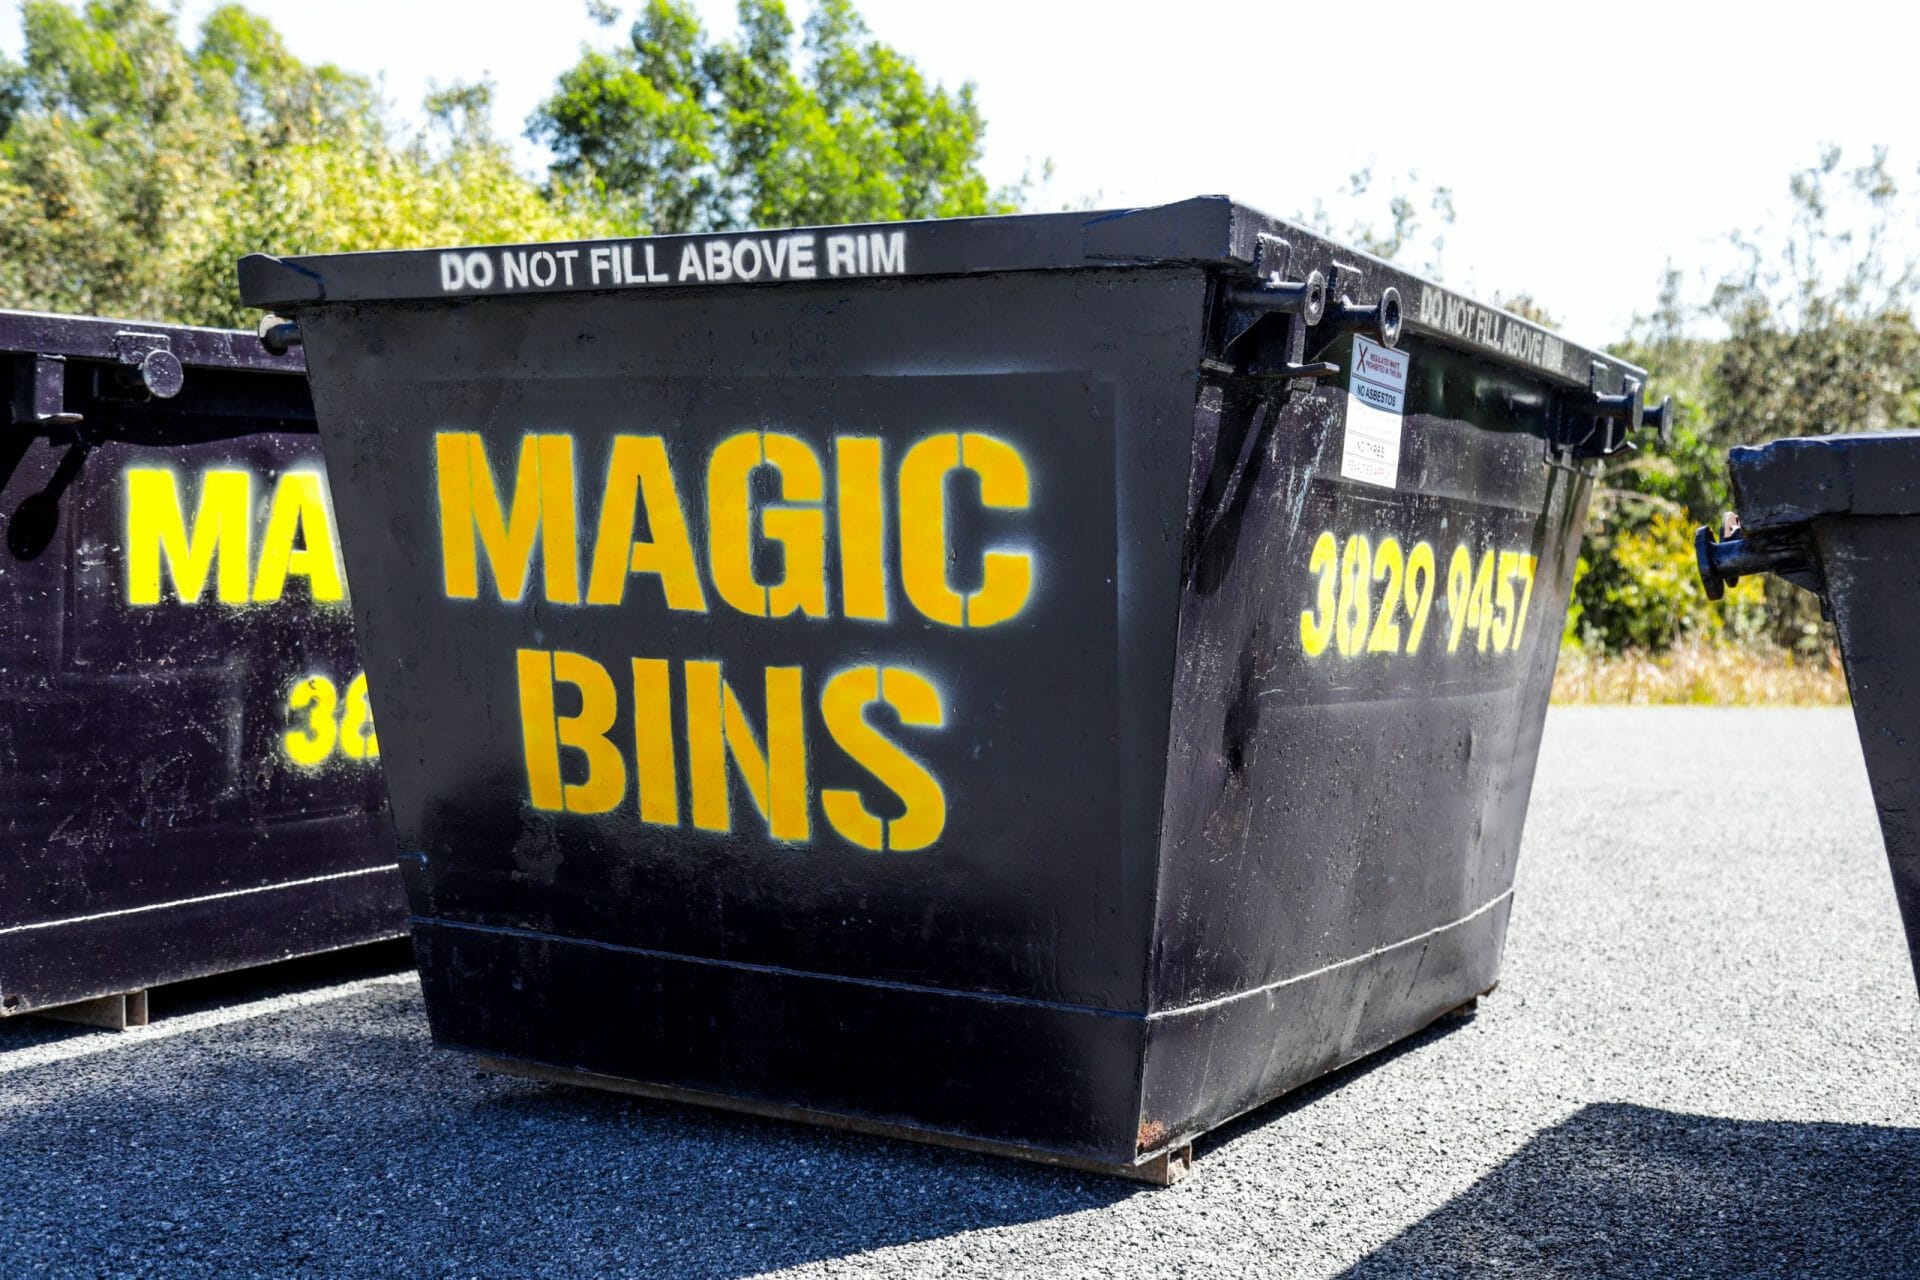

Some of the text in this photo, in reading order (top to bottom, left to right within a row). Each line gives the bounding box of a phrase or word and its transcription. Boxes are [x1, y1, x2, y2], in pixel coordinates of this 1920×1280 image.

[440, 232, 905, 291] DO NOT FILL ABOVE RIM
[1420, 285, 1443, 328] DO
[1445, 296, 1476, 339] NOT
[1476, 308, 1501, 350] FILL
[1502, 320, 1543, 367] ABOVE
[1357, 384, 1396, 407] NO ASBESTOS
[127, 469, 344, 605] MA
[436, 432, 1031, 628] MAGIC
[1300, 530, 1538, 657] 3829 9457
[517, 649, 946, 851] BINS
